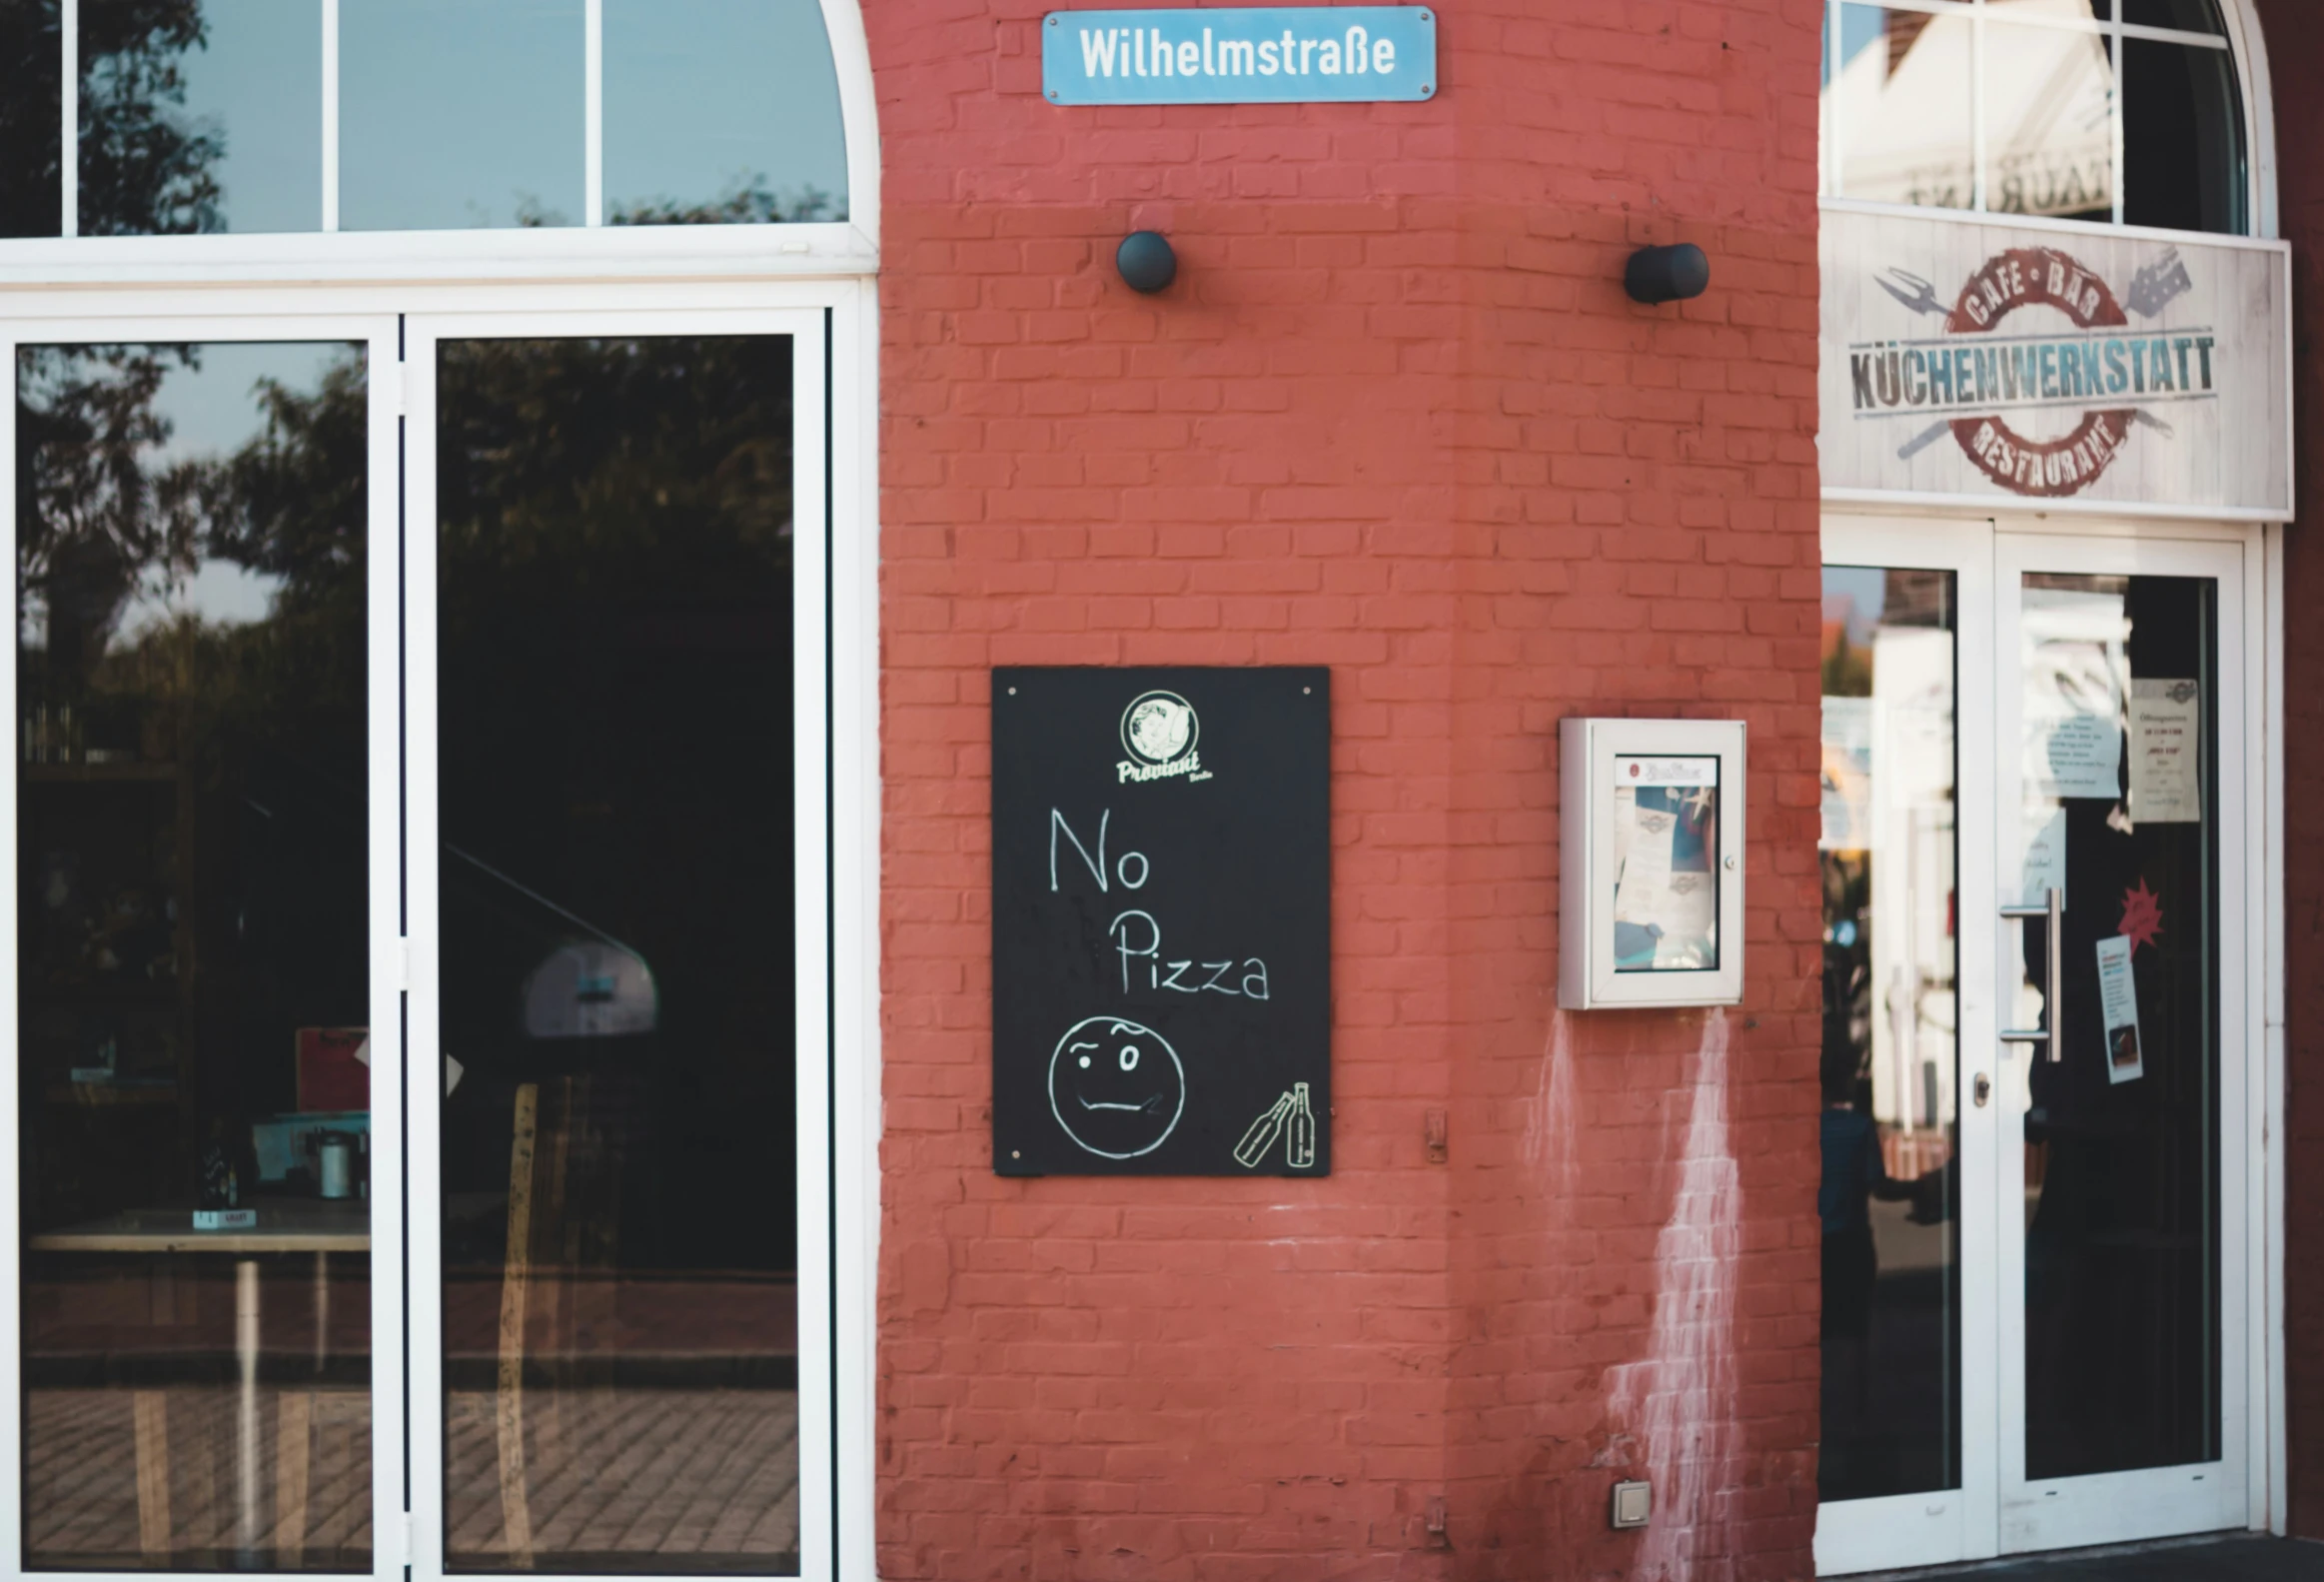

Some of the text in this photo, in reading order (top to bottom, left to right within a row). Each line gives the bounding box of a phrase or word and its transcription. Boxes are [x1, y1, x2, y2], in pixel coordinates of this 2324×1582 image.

[1080, 26, 1396, 77] Wilhelmstraße
[2047, 262, 2100, 321] BAR
[1850, 337, 2214, 410] KÜCHENWERKSTATT
[1972, 414, 2115, 488] RESTAURANT
[1116, 751, 1201, 784] Proviant
[1051, 807, 1149, 892] No
[1110, 909, 1270, 1000] Pizza
